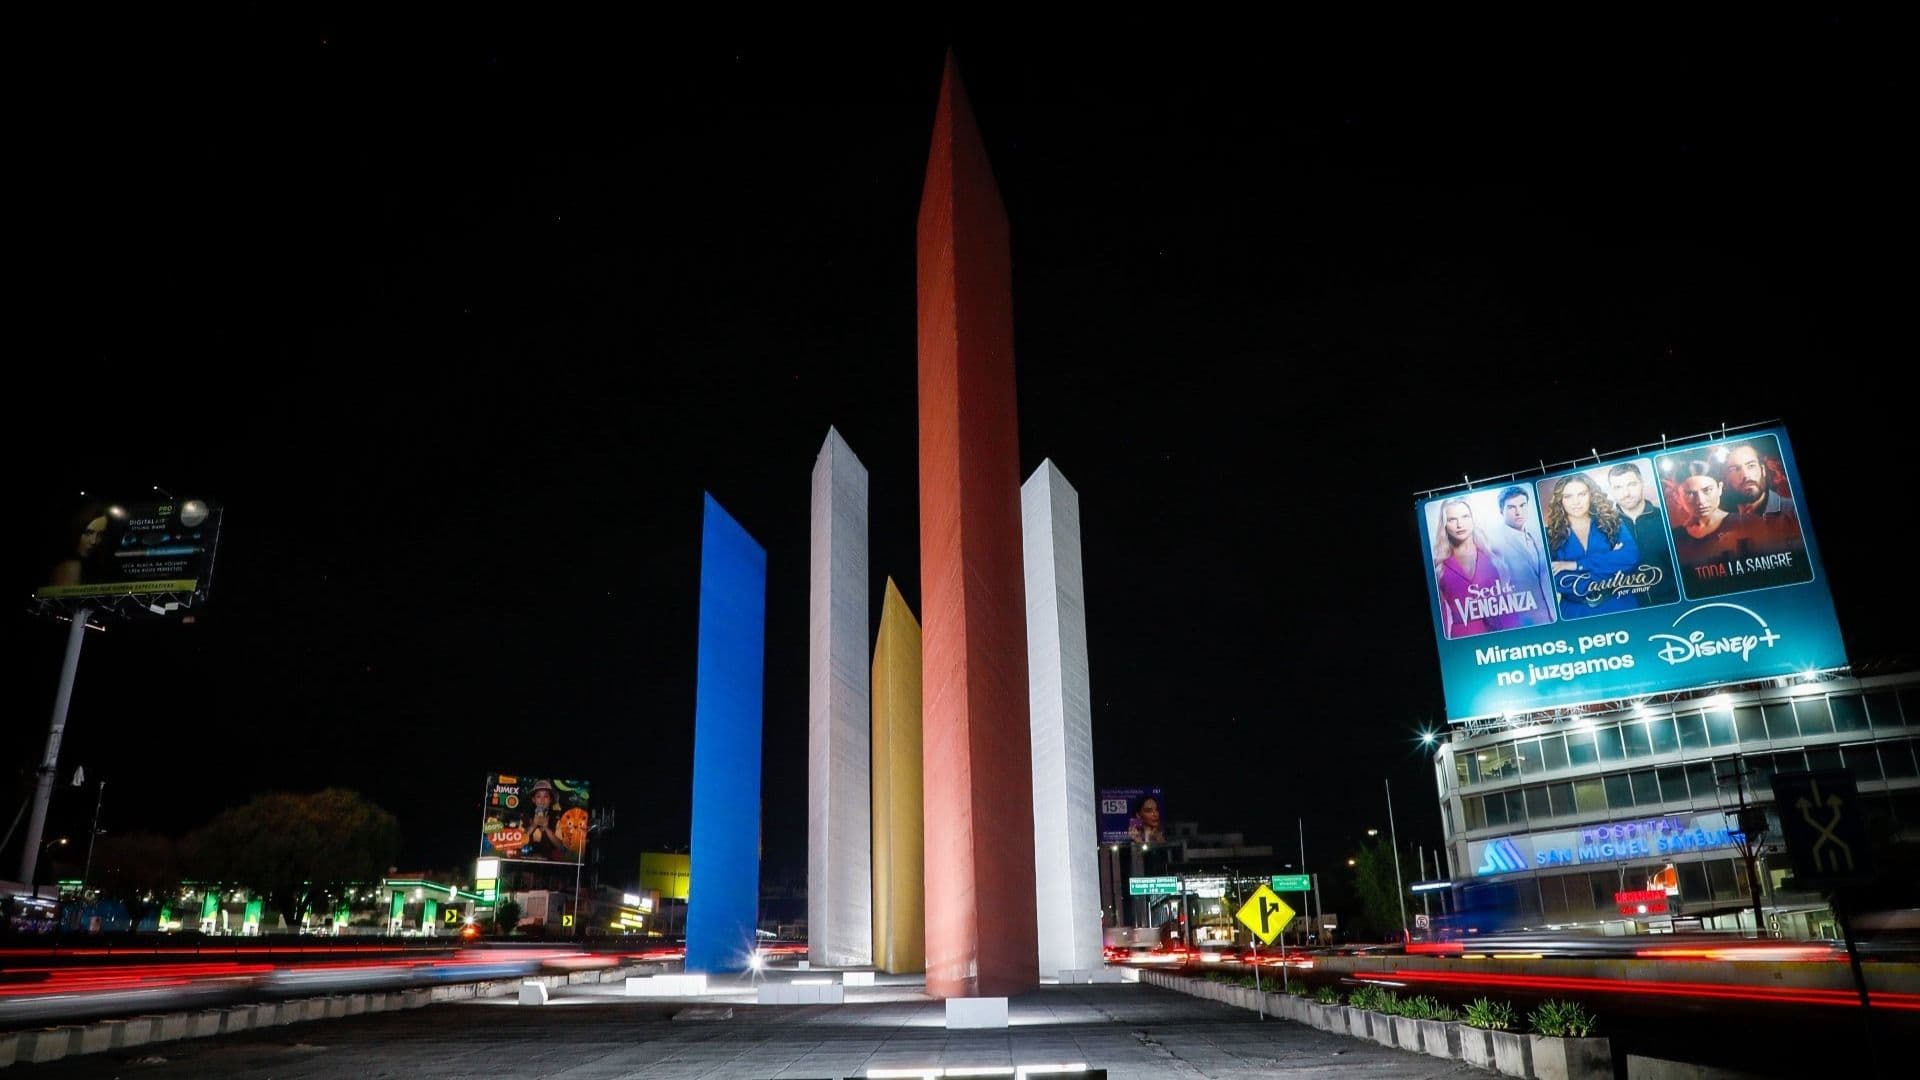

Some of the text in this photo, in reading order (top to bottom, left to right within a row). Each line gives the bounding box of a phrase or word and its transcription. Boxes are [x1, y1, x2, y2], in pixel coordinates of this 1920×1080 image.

[129, 518, 154, 526] DIGITAL
[1694, 551, 1793, 580] TODA LA SANGRE
[1467, 580, 1515, 601] Sed de
[1559, 565, 1663, 598] Cautiva
[1617, 586, 1651, 600] por amor
[1455, 590, 1537, 627] VENGANZA
[1475, 628, 1630, 666] Miramos, pero
[1497, 654, 1635, 687] no juzgamos
[493, 784, 520, 795] JUMEX
[492, 831, 522, 842] JUGO
[1582, 818, 1685, 844] HOSPITAL
[1536, 847, 1572, 866] SAN
[1579, 839, 1649, 861] MIGUEL
